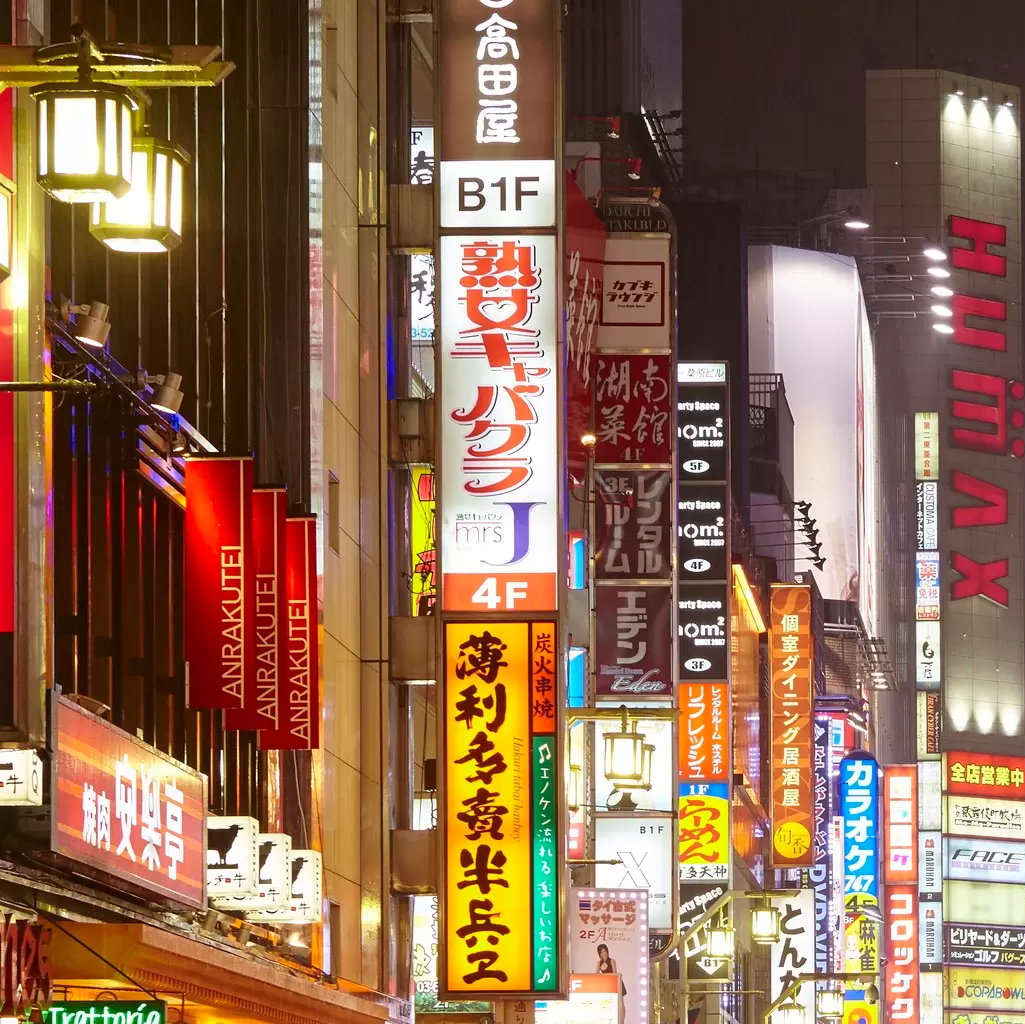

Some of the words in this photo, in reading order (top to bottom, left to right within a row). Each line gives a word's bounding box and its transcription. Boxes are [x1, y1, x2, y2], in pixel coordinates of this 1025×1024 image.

[475, 13, 520, 144] 高田屋
[456, 176, 540, 212] B1F
[606, 292, 658, 303] ラウンジ
[612, 280, 653, 291] カブキ
[450, 241, 551, 497] 熟女キャバクラ
[596, 358, 667, 402] 湖南
[600, 406, 668, 446] 菜館
[619, 447, 643, 461] 4F
[690, 462, 703, 471] 5F
[925, 484, 935, 525] CUSTOMA
[637, 475, 662, 574] レンタル
[925, 527, 936, 548] CAFE
[690, 562, 704, 570] 4F
[471, 577, 528, 609] 4F
[918, 588, 938, 599] 免税
[221, 545, 244, 699] ANRAKUTEI
[616, 591, 648, 665] エデン
[256, 573, 278, 721] ANRAKUTEI
[288, 599, 310, 741] ANRAKUTEI
[533, 632, 555, 719] 炭火串焼
[691, 661, 705, 670] 3F
[611, 669, 667, 692] Eden
[781, 614, 801, 807] 個室ダイニング居酒屋
[687, 685, 706, 778] リフレッシュ
[951, 763, 1025, 787] 全店営業中
[689, 785, 709, 795] 1F
[82, 782, 111, 851] 焼肉
[845, 761, 873, 872] カラオケ
[639, 826, 665, 834] B1F
[952, 849, 1025, 865] FACE
[844, 875, 874, 892] 747
[592, 900, 636, 913] タイ古式
[578, 914, 636, 926] マッサージ
[579, 930, 596, 939] 2F
[859, 918, 876, 972] 麻雀
[704, 959, 718, 967] B1
[974, 949, 999, 963] ゴルフ
